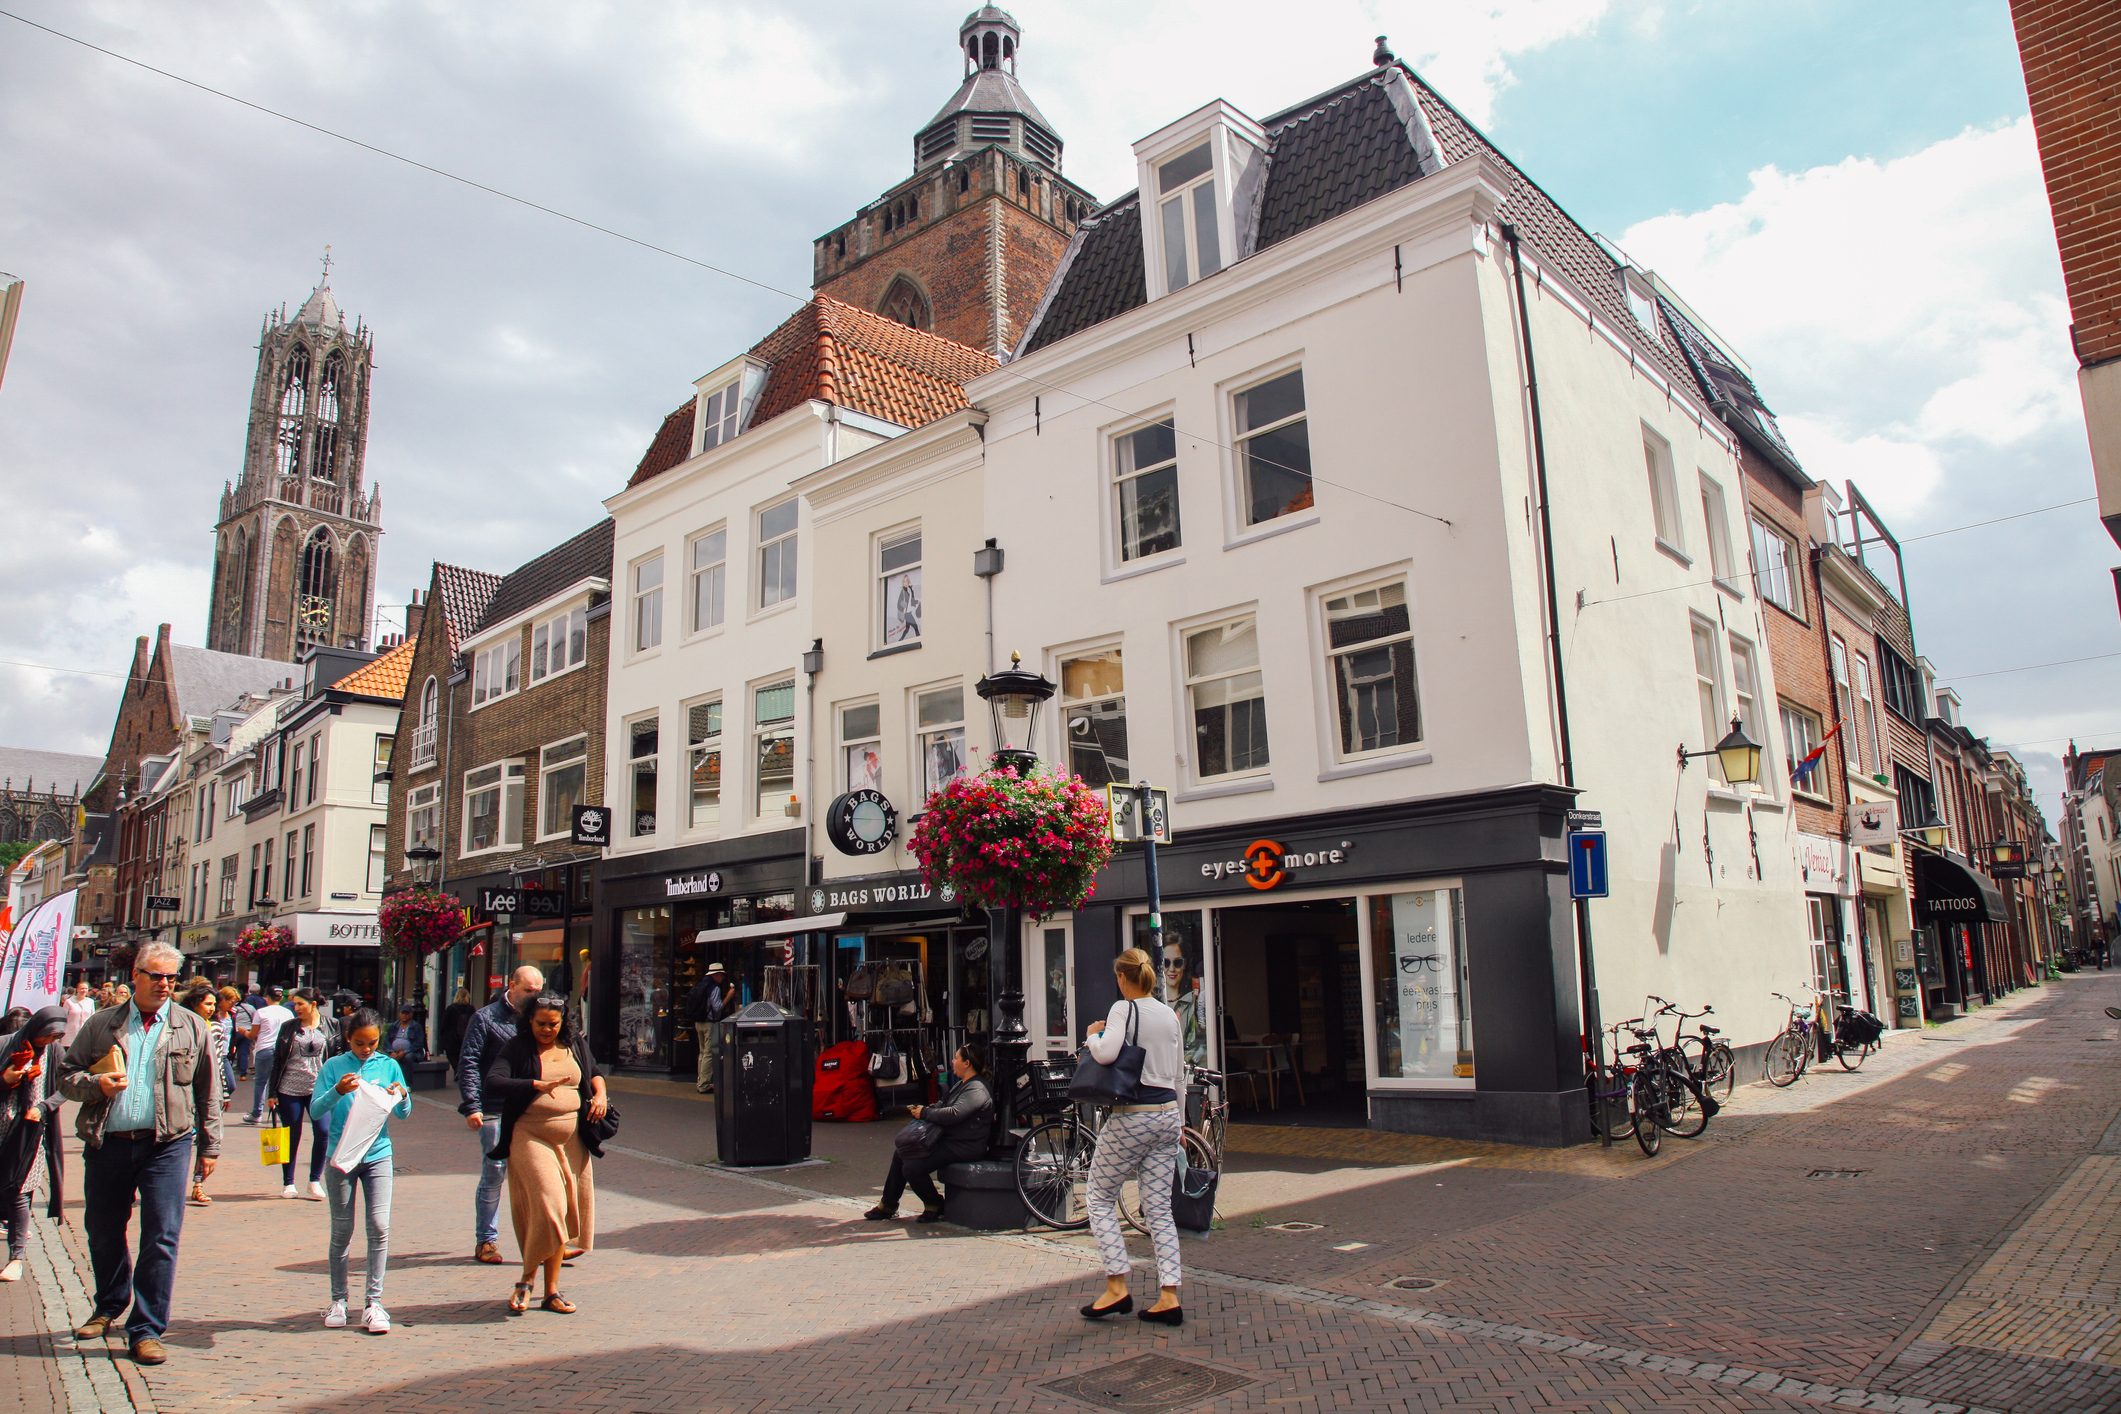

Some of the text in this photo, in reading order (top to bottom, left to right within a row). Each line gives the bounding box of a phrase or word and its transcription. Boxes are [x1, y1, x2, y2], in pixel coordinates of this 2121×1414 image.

[848, 791, 890, 812] BAGS
[1568, 811, 1601, 821] Donkerstraat
[578, 833, 605, 843] Timberland
[845, 828, 893, 852] WORLD
[1201, 849, 1343, 880] eyes more
[665, 875, 707, 896] Timberland
[829, 889, 868, 907] BAGS
[873, 883, 931, 903] WORLD
[152, 897, 171, 909] JAZZ
[484, 891, 516, 912] Lee
[1928, 897, 1977, 912] TATTOOS
[1407, 931, 1437, 944] Iedere
